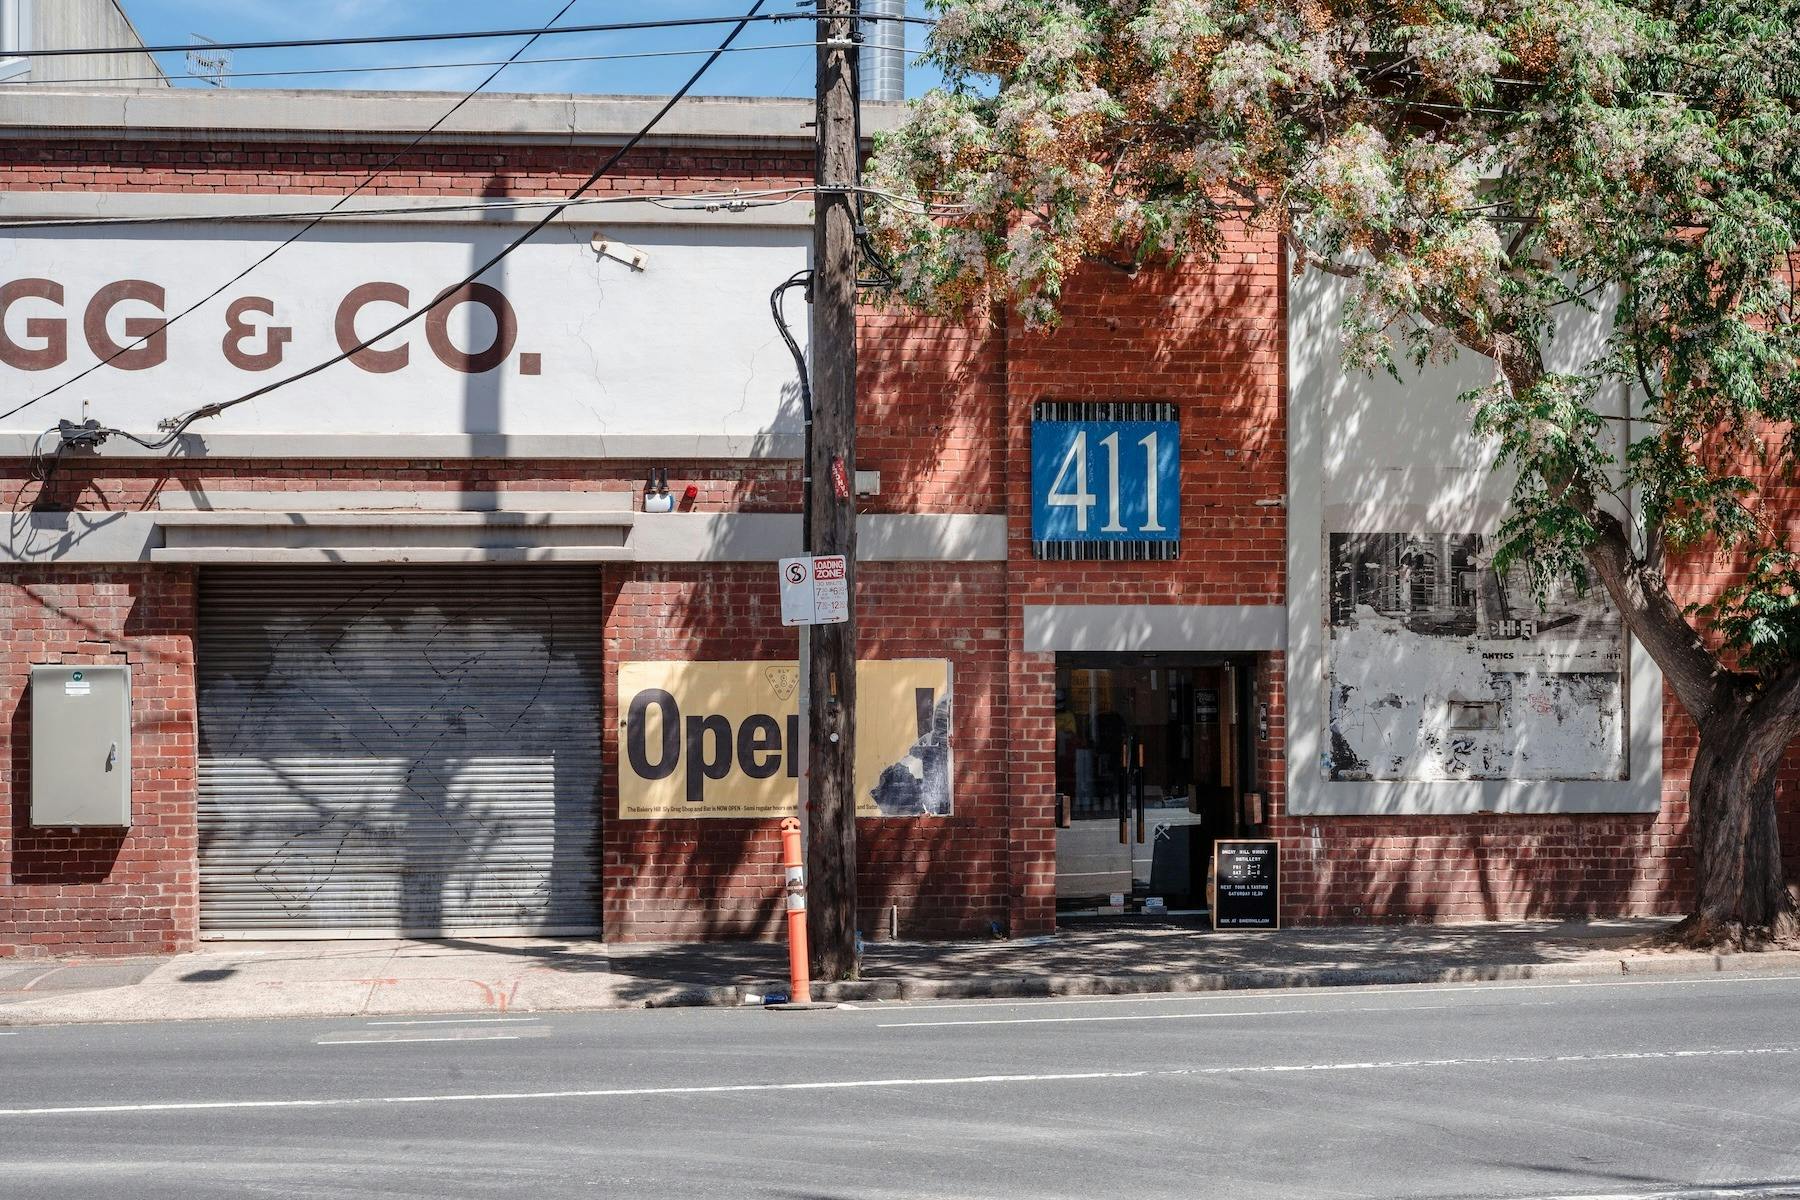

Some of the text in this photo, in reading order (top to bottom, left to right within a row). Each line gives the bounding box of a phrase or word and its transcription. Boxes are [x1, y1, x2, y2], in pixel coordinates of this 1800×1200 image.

[222, 296, 292, 372] &
[334, 281, 541, 376] CO.
[1047, 431, 1166, 532] 411
[814, 560, 843, 570] LOADING
[816, 569, 843, 579] ZONE
[1481, 652, 1514, 660] ANTICS
[626, 687, 800, 802] Ope
